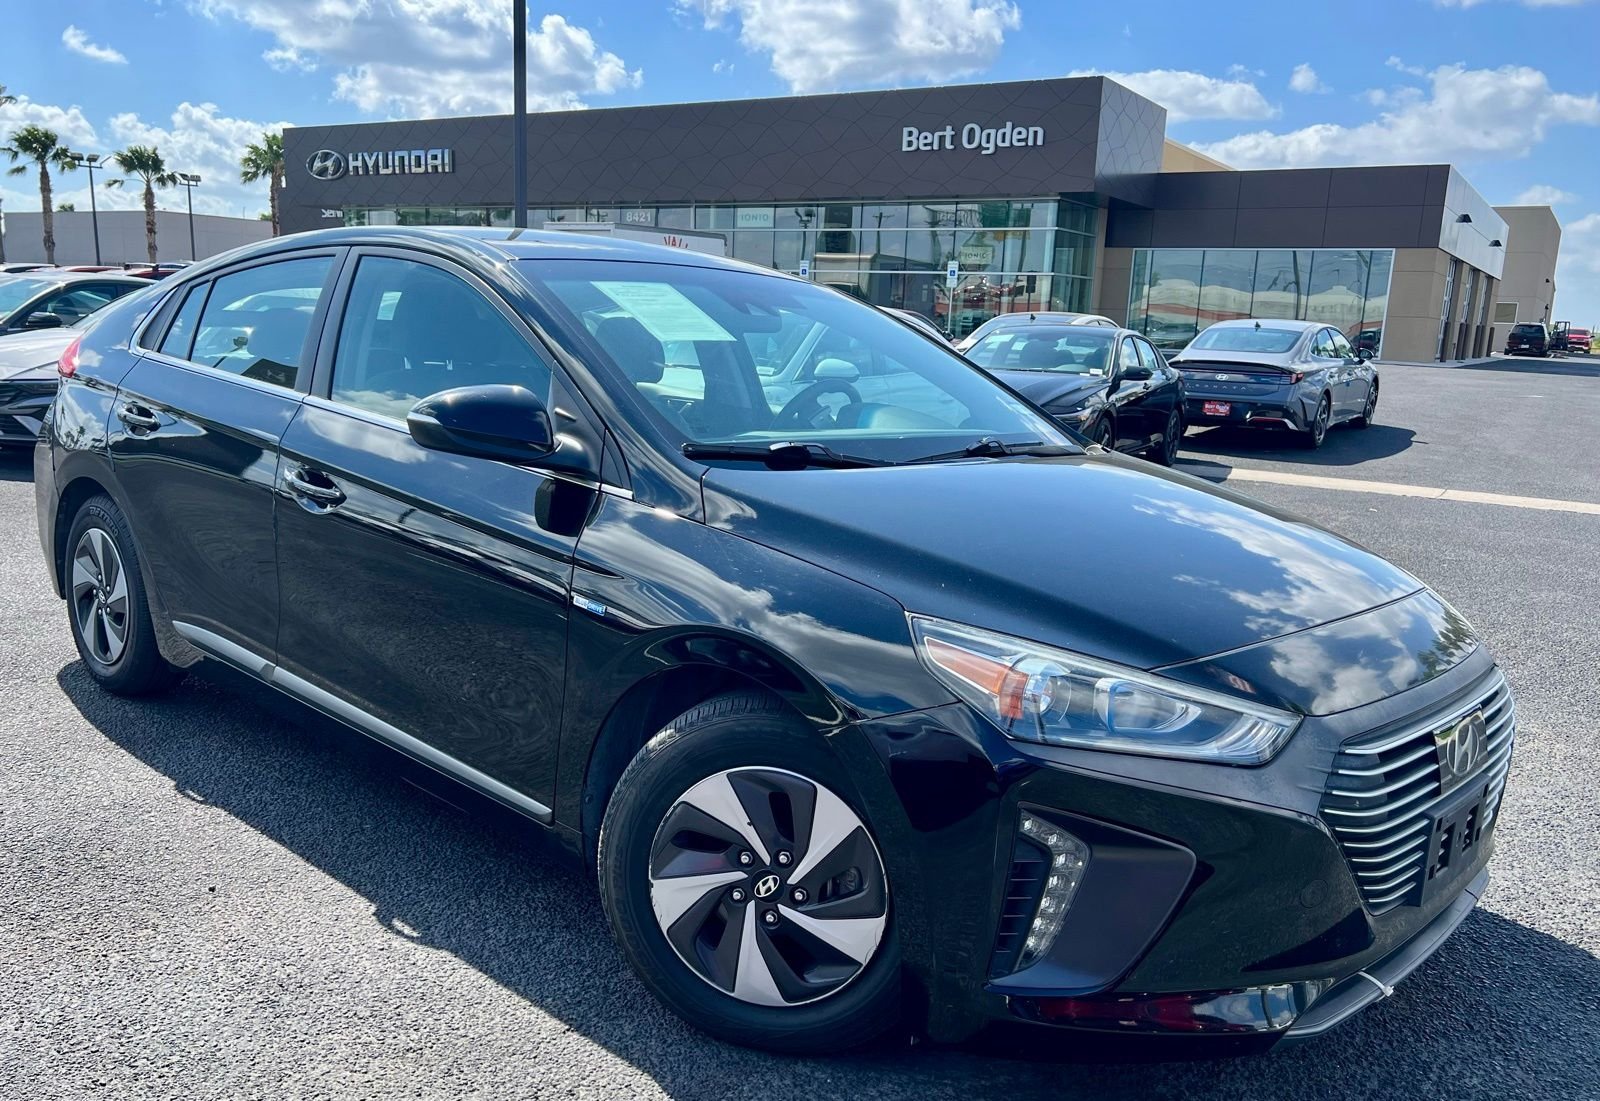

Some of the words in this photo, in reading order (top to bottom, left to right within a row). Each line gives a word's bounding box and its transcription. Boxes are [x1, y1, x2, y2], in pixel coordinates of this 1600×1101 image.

[902, 125, 956, 152] Bert
[962, 121, 1045, 155] Ogden
[348, 148, 453, 176] HYUNDAI
[626, 211, 651, 222] 8421
